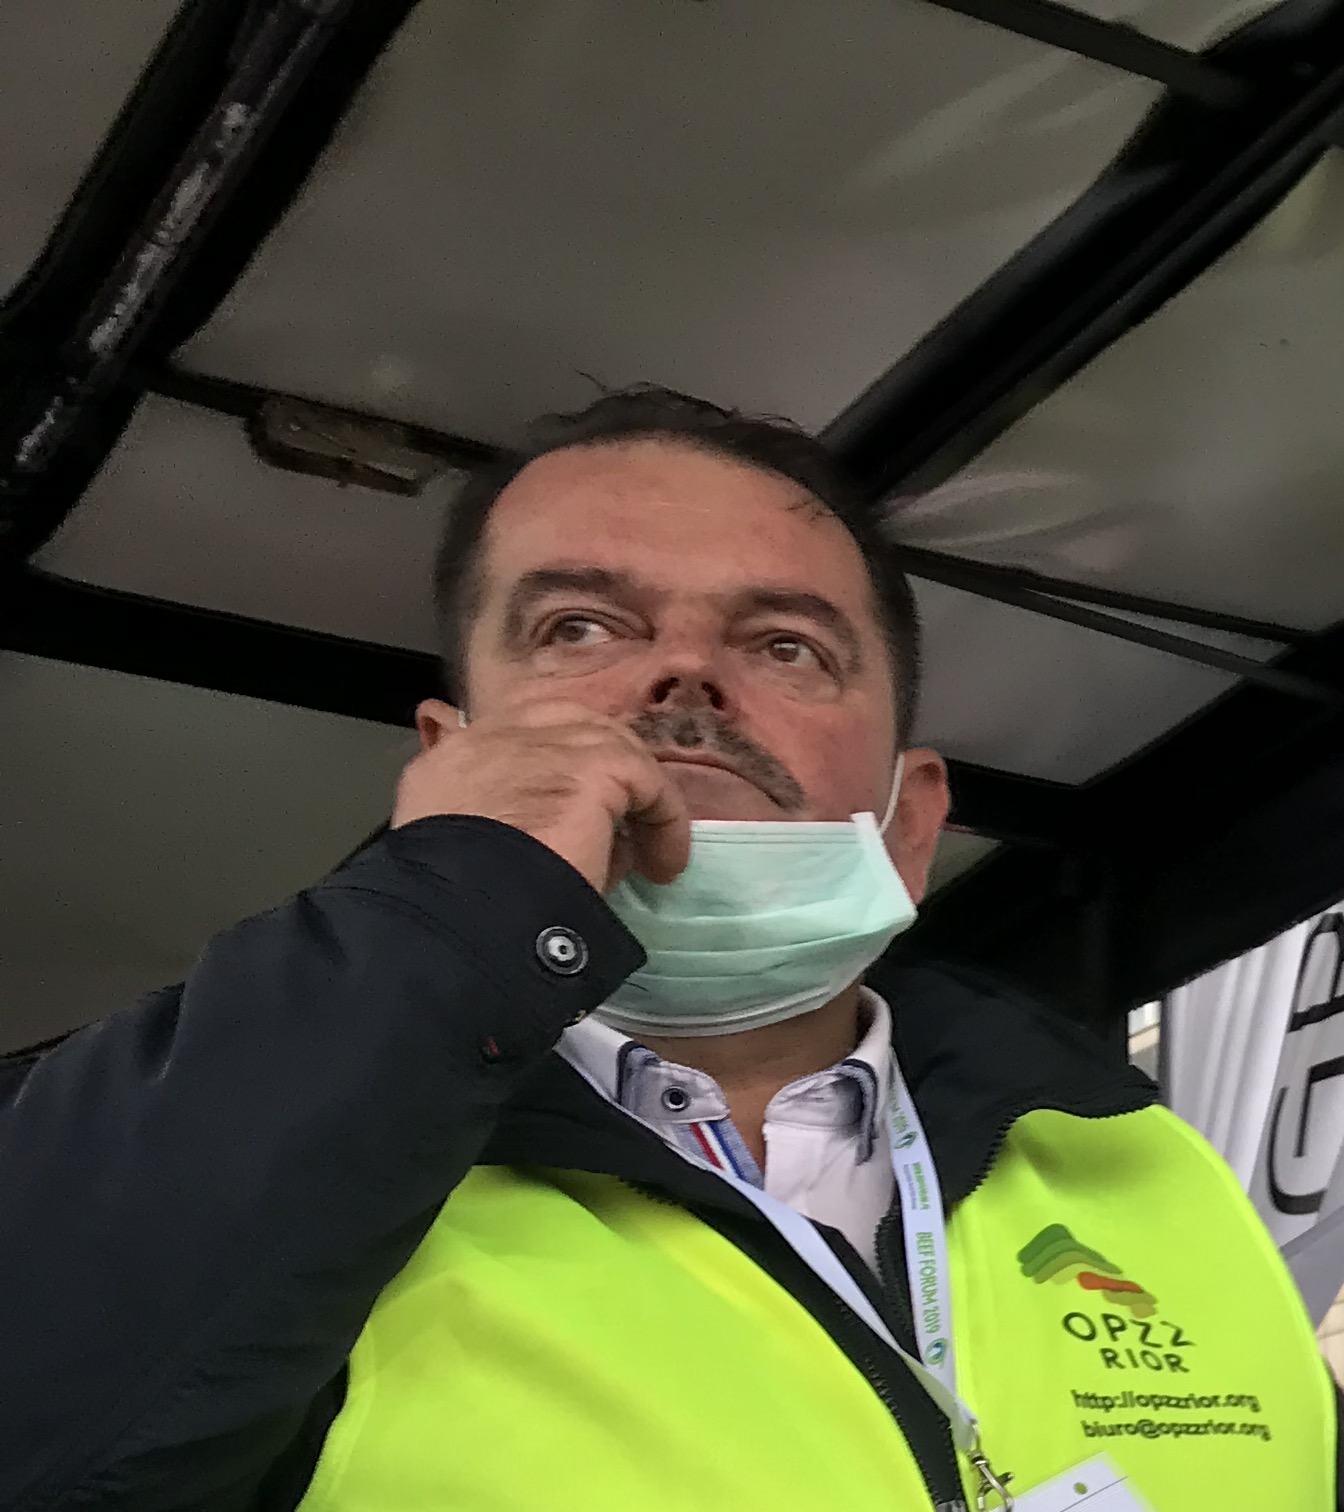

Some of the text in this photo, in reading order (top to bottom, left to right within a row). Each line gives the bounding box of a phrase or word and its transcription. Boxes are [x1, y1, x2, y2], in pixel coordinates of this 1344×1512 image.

[915, 1231, 936, 1257] BEEF
[919, 1258, 938, 1306] FORUM
[922, 1305, 941, 1334] 2019
[1062, 1311, 1196, 1348] OPZZ
[1099, 1347, 1190, 1373] RIOR
